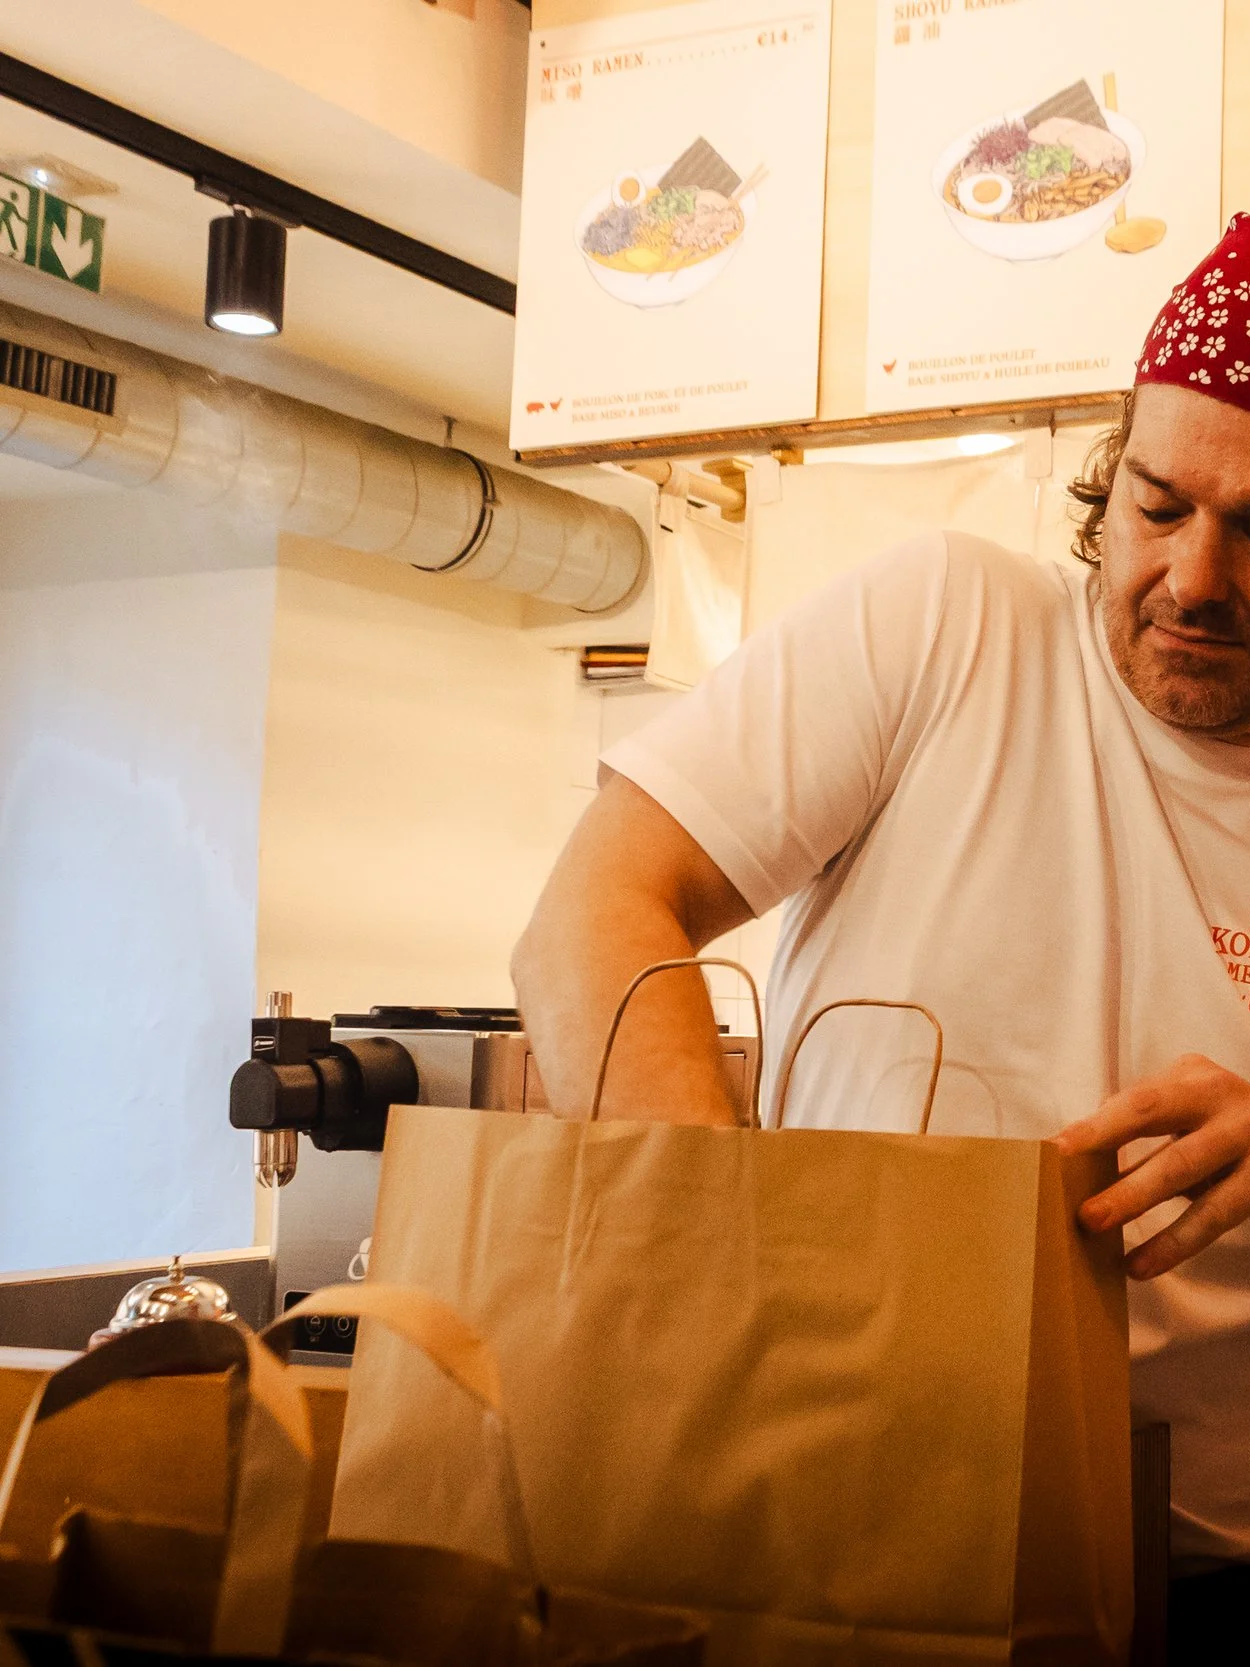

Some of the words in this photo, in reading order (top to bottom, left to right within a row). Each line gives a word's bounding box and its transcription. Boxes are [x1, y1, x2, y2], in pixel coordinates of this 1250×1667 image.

[541, 63, 582, 83] MISO
[592, 51, 644, 76] RAMEN
[908, 355, 967, 371] BOUILLON
[970, 353, 986, 365] DE
[989, 348, 1038, 363] POULET
[908, 373, 937, 387] BASE
[940, 370, 981, 384] SHOYU
[994, 366, 1032, 379] HUILE
[1035, 363, 1052, 375] DE
[1055, 356, 1111, 373] POIREAU
[572, 392, 624, 408] BOUILLON
[690, 384, 705, 397] DE
[707, 379, 749, 395] POULET
[571, 410, 598, 425] BASE
[600, 408, 627, 421] MISO
[638, 402, 681, 418] BEURRE
